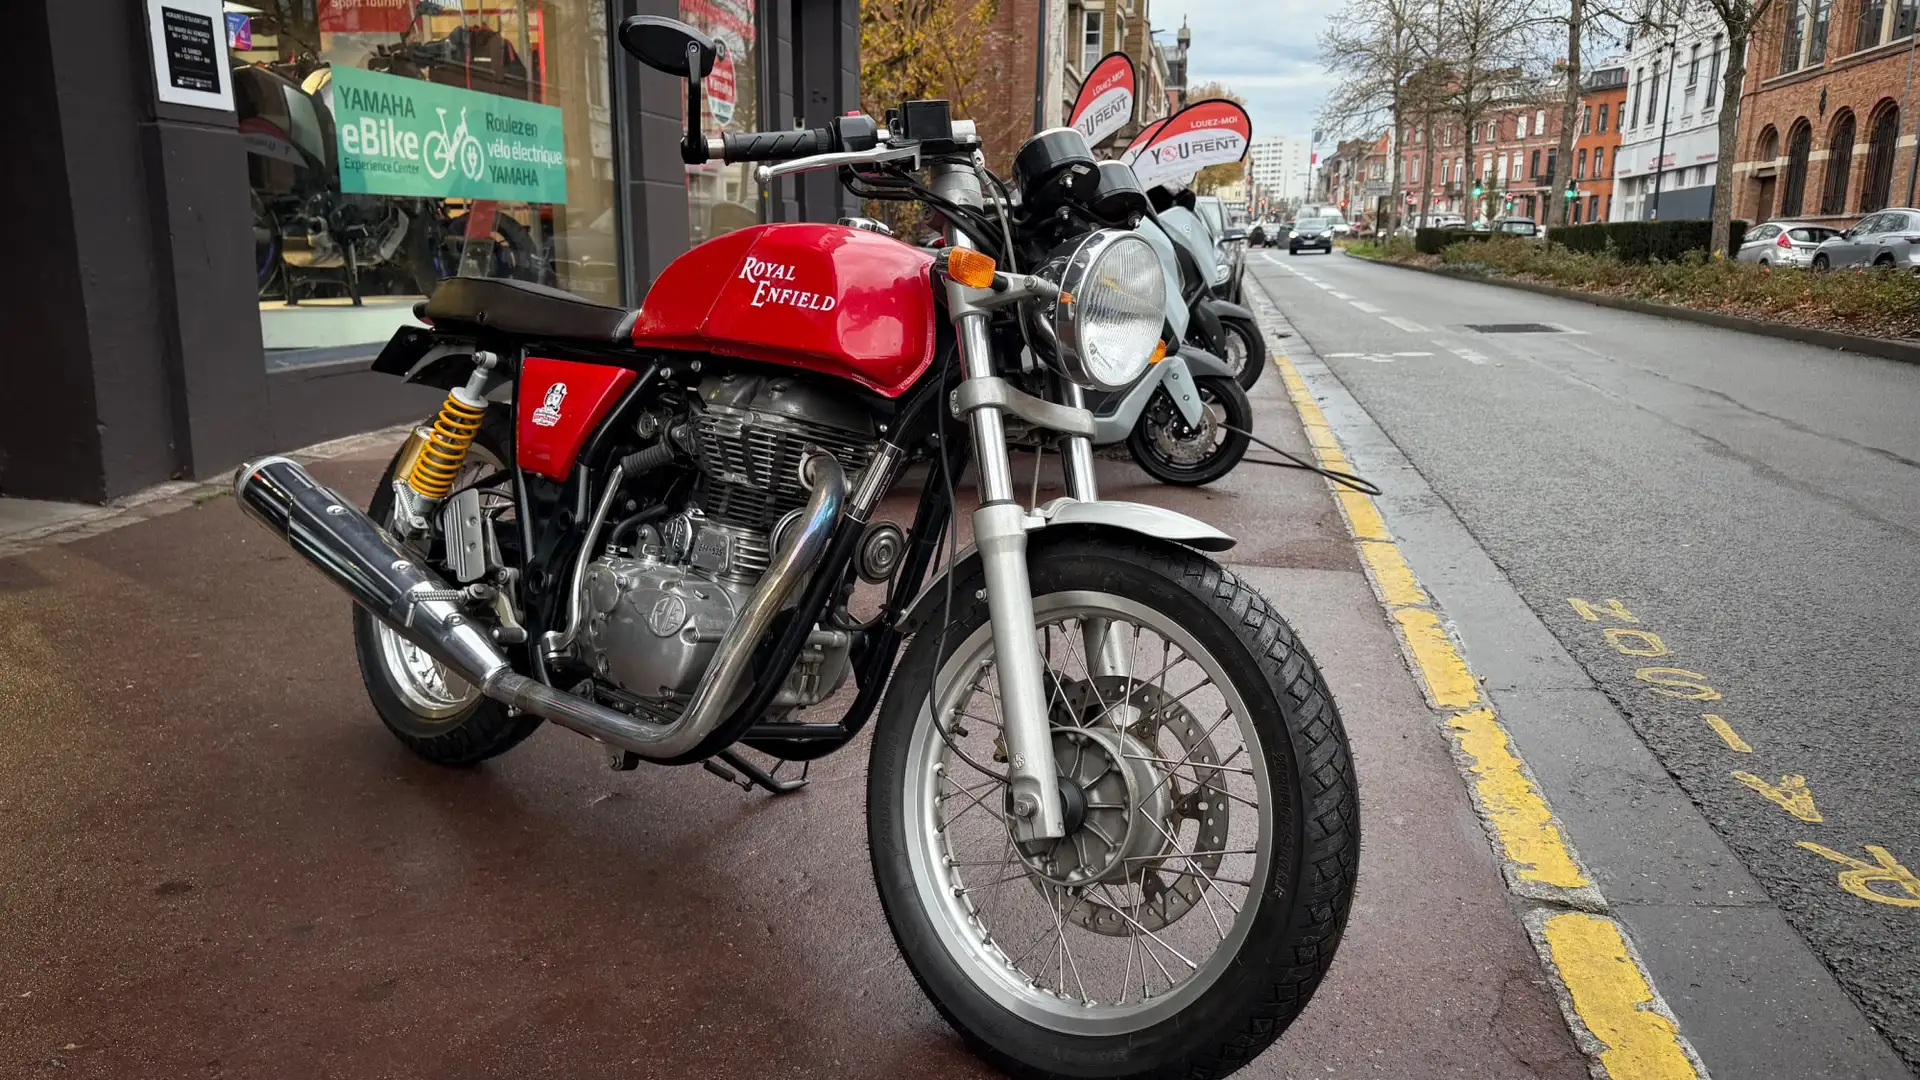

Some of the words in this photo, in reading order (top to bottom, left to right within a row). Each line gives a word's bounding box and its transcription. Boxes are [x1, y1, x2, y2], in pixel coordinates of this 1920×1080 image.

[1091, 69, 1126, 97] LOUEZ-MOI
[339, 85, 416, 118] YAMAHA
[1095, 95, 1128, 127] RENT
[486, 112, 524, 135] Roulez
[525, 122, 538, 138] en
[1190, 116, 1238, 129] LOUEZ-MOI
[341, 116, 420, 160] eBike
[1192, 138, 1240, 155] RENT
[344, 157, 392, 174] Experience
[393, 160, 420, 174] Center
[487, 139, 511, 158] vélo
[512, 141, 563, 169] électrique
[489, 165, 540, 187] YAMAHA
[738, 256, 796, 283] ROYAL
[750, 280, 836, 311] ENFIELD
